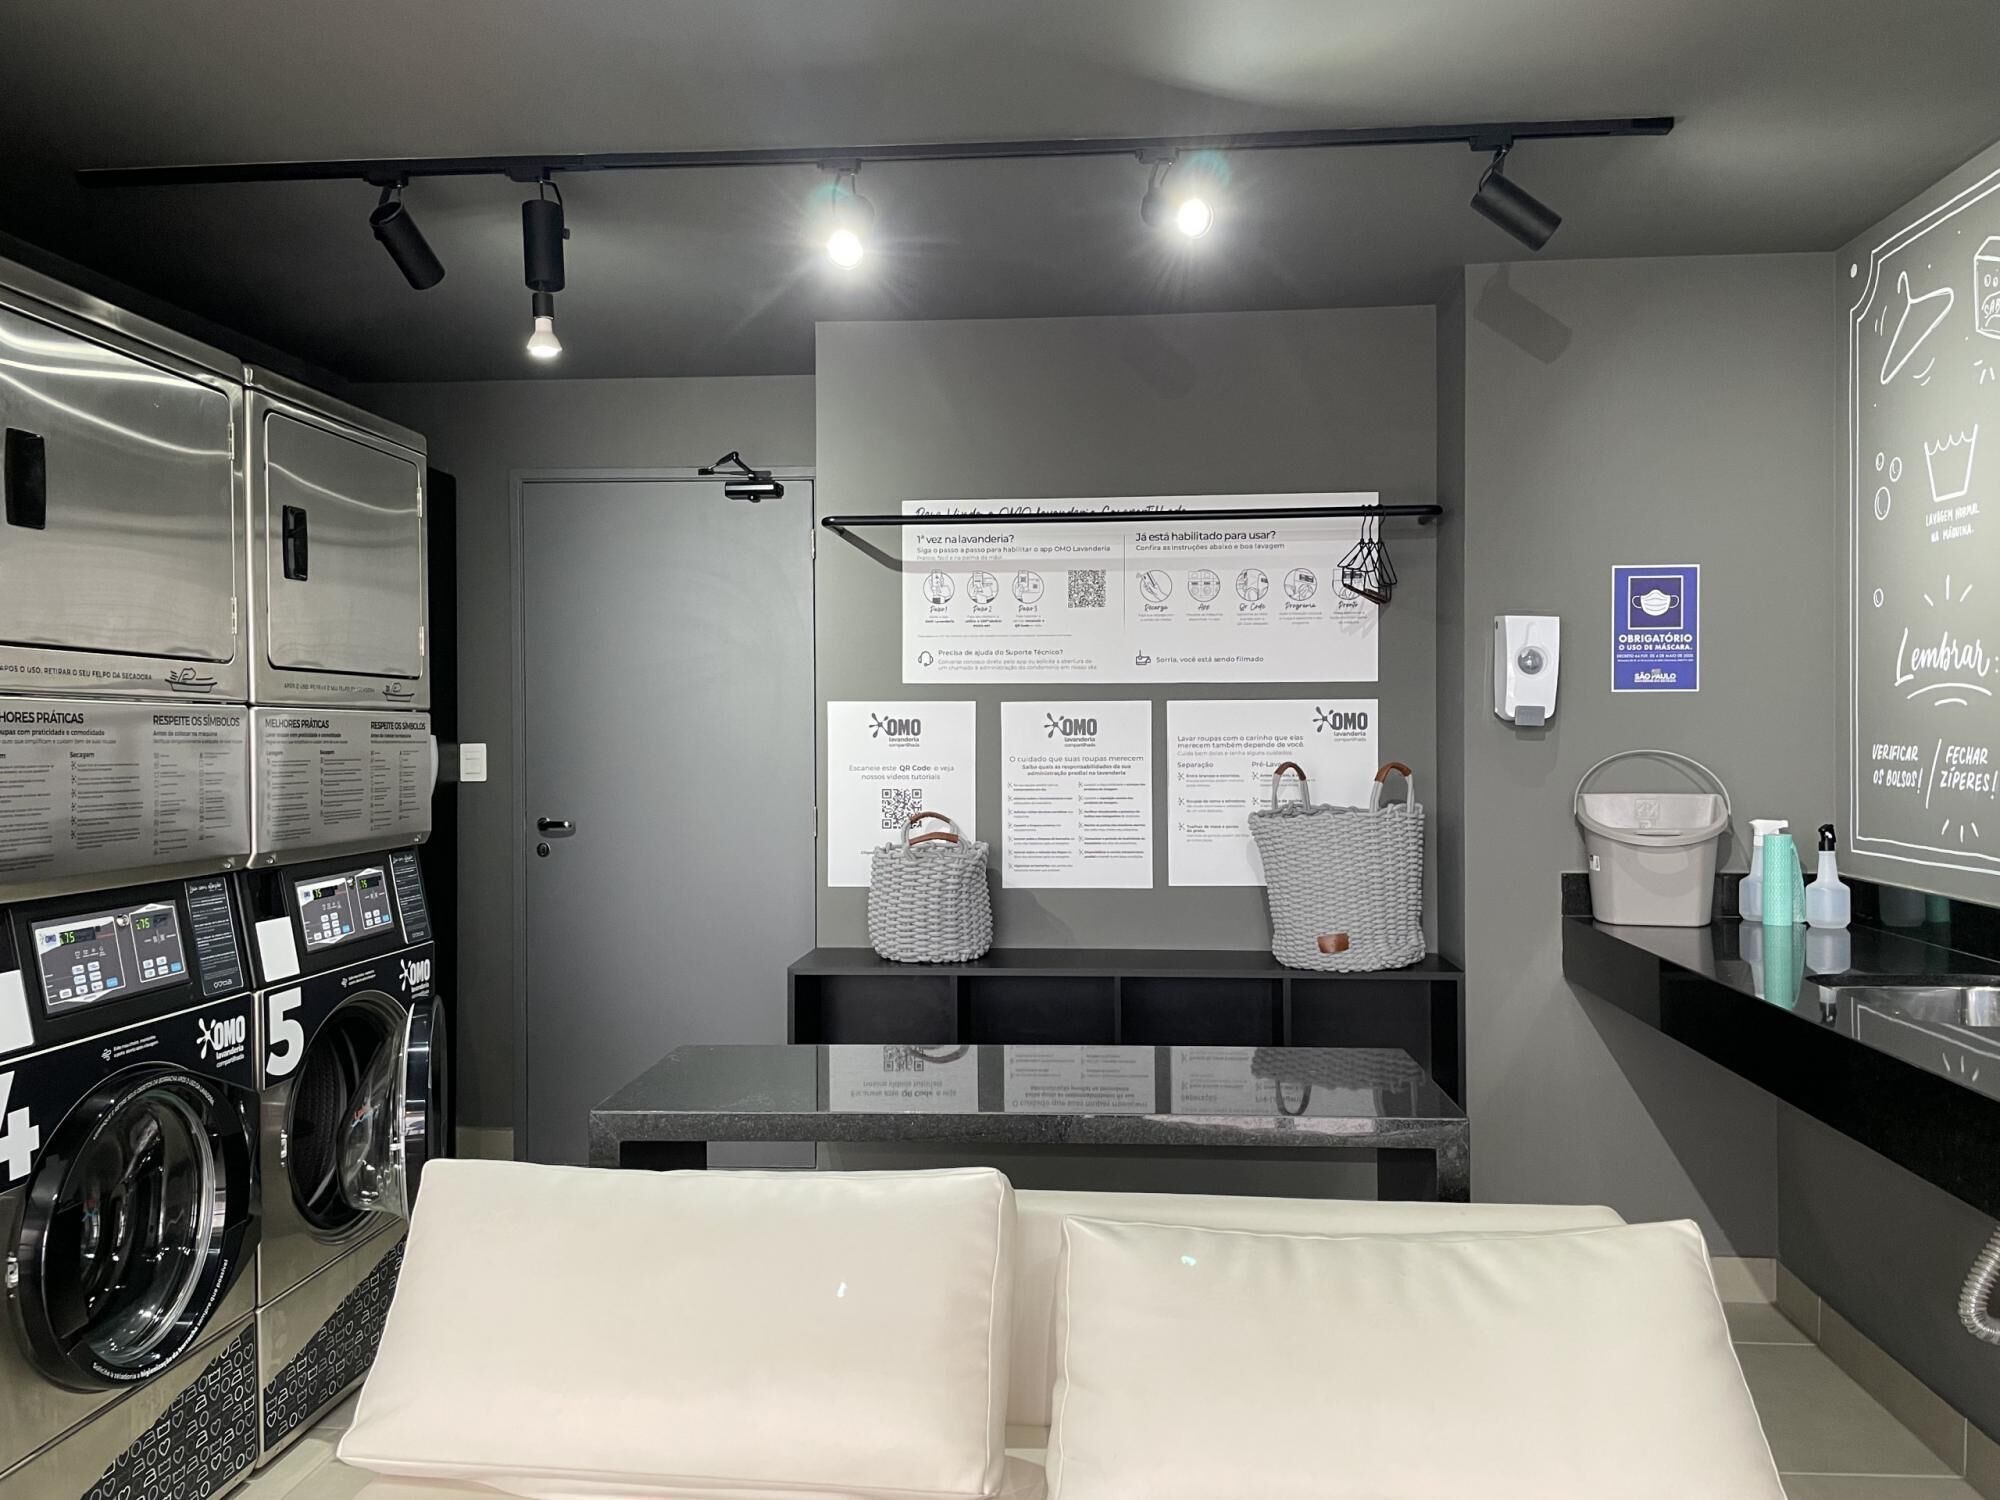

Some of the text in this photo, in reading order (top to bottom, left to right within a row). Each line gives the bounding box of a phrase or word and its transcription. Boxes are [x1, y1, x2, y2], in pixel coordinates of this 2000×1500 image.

[1926, 508, 1953, 526] LAVAGEM
[958, 534, 1015, 543] lavanderia?
[1136, 533, 1147, 541] Já
[1171, 531, 1223, 540] habilitado
[1224, 533, 1247, 541] para
[1248, 531, 1275, 539] usar?
[1931, 530, 1939, 543] NA
[1619, 632, 1692, 642] OBRIGATÓRIO
[1895, 628, 2000, 686] Lembrar:
[122, 672, 152, 682] SECADORA
[1635, 672, 1676, 680] SÃO PAULO
[36, 711, 84, 724] PRÁTICAS
[153, 715, 240, 726] RESPEITE OS SÍMBOLOS
[265, 718, 329, 728] MELHORES PRÁTICAS
[1332, 712, 1368, 730] OMO
[887, 718, 921, 736] OMO
[1062, 718, 1097, 736] OMO
[1872, 744, 1918, 761] VERIFICAR
[1946, 746, 1988, 765] FECHAR
[1873, 768, 1923, 794] OS BOLSOS!
[1940, 766, 1998, 799] ZÍPERES!
[410, 958, 430, 985] OMO
[214, 1015, 246, 1051] OMO
[266, 986, 304, 1076] 5
[216, 1044, 244, 1060] lavanderia
[0, 1070, 40, 1182] 4
